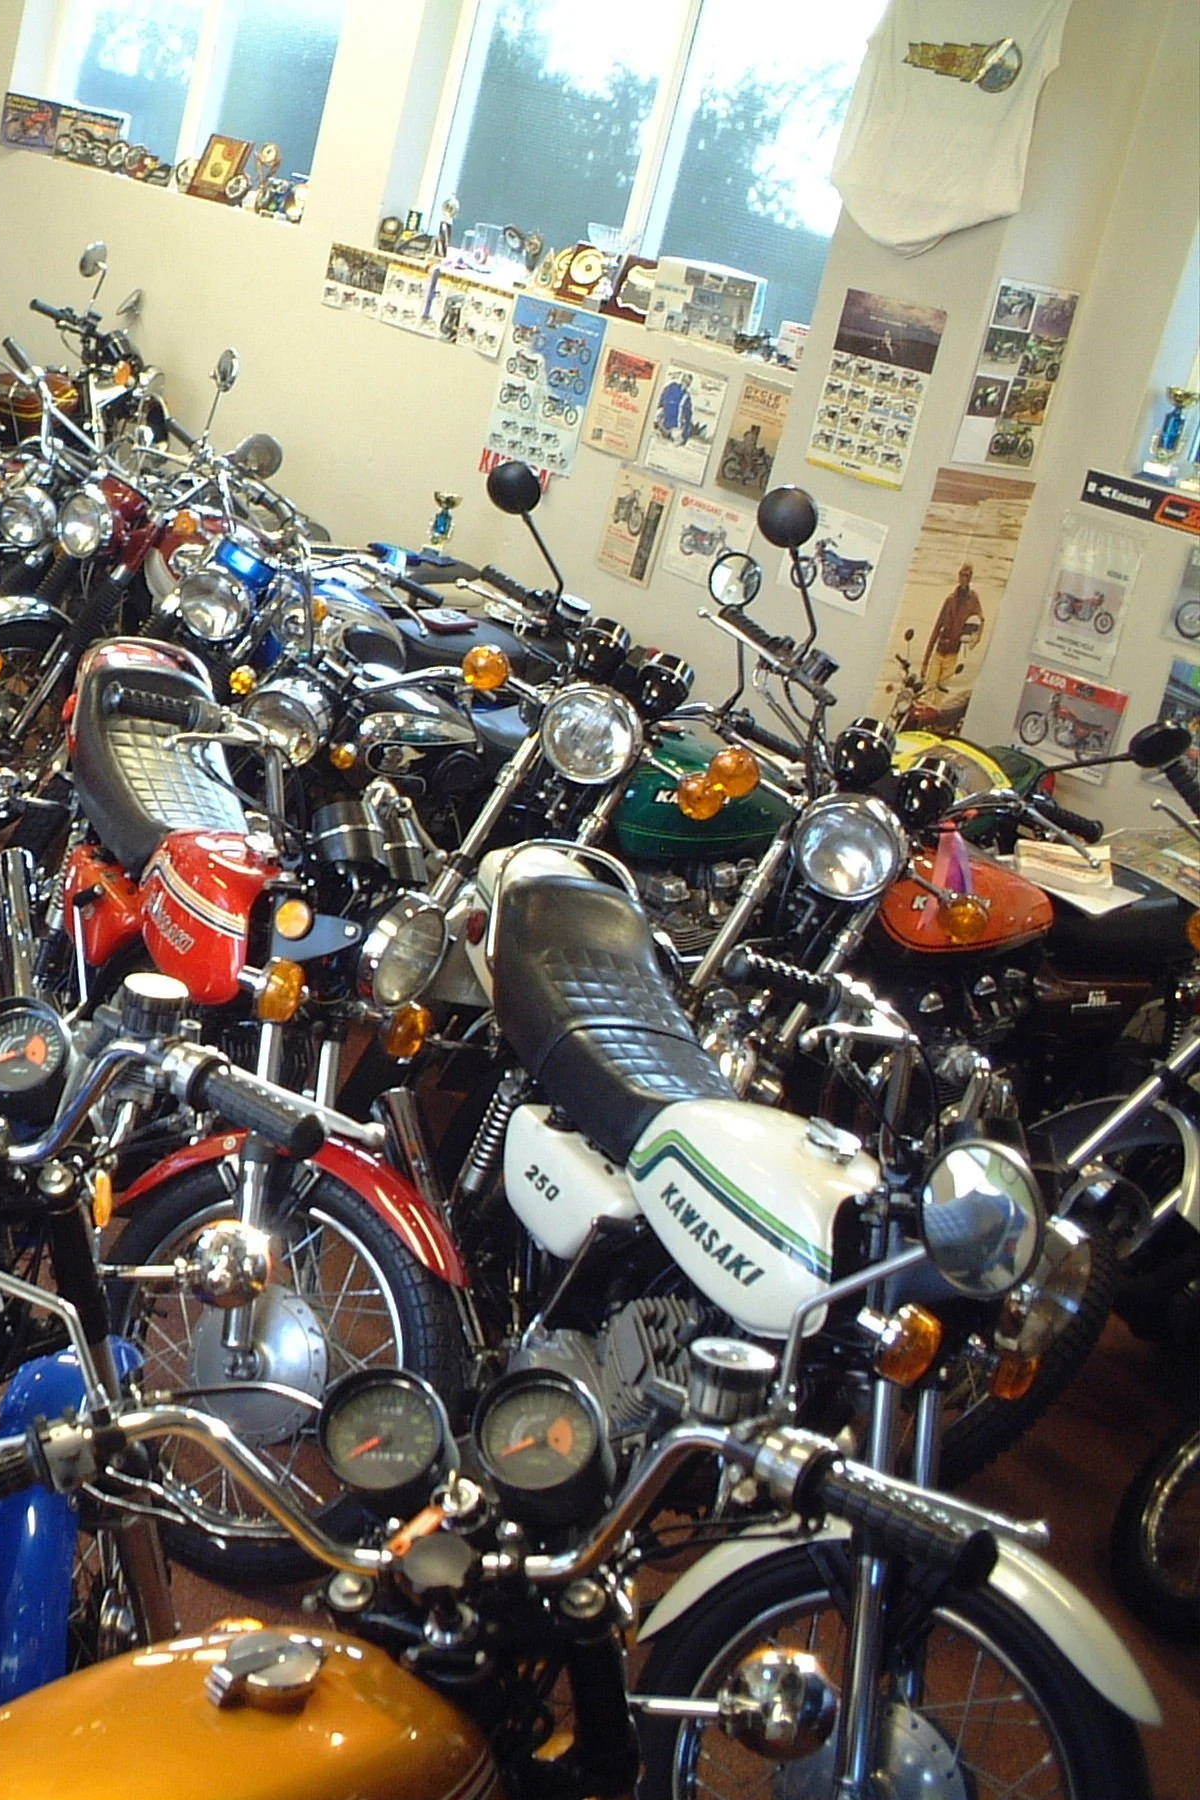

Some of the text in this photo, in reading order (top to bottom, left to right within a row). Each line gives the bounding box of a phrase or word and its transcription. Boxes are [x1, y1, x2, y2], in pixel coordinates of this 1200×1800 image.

[743, 384, 783, 402] CYCLE
[522, 1162, 560, 1203] 250
[657, 1180, 767, 1288] KAWASAKI
